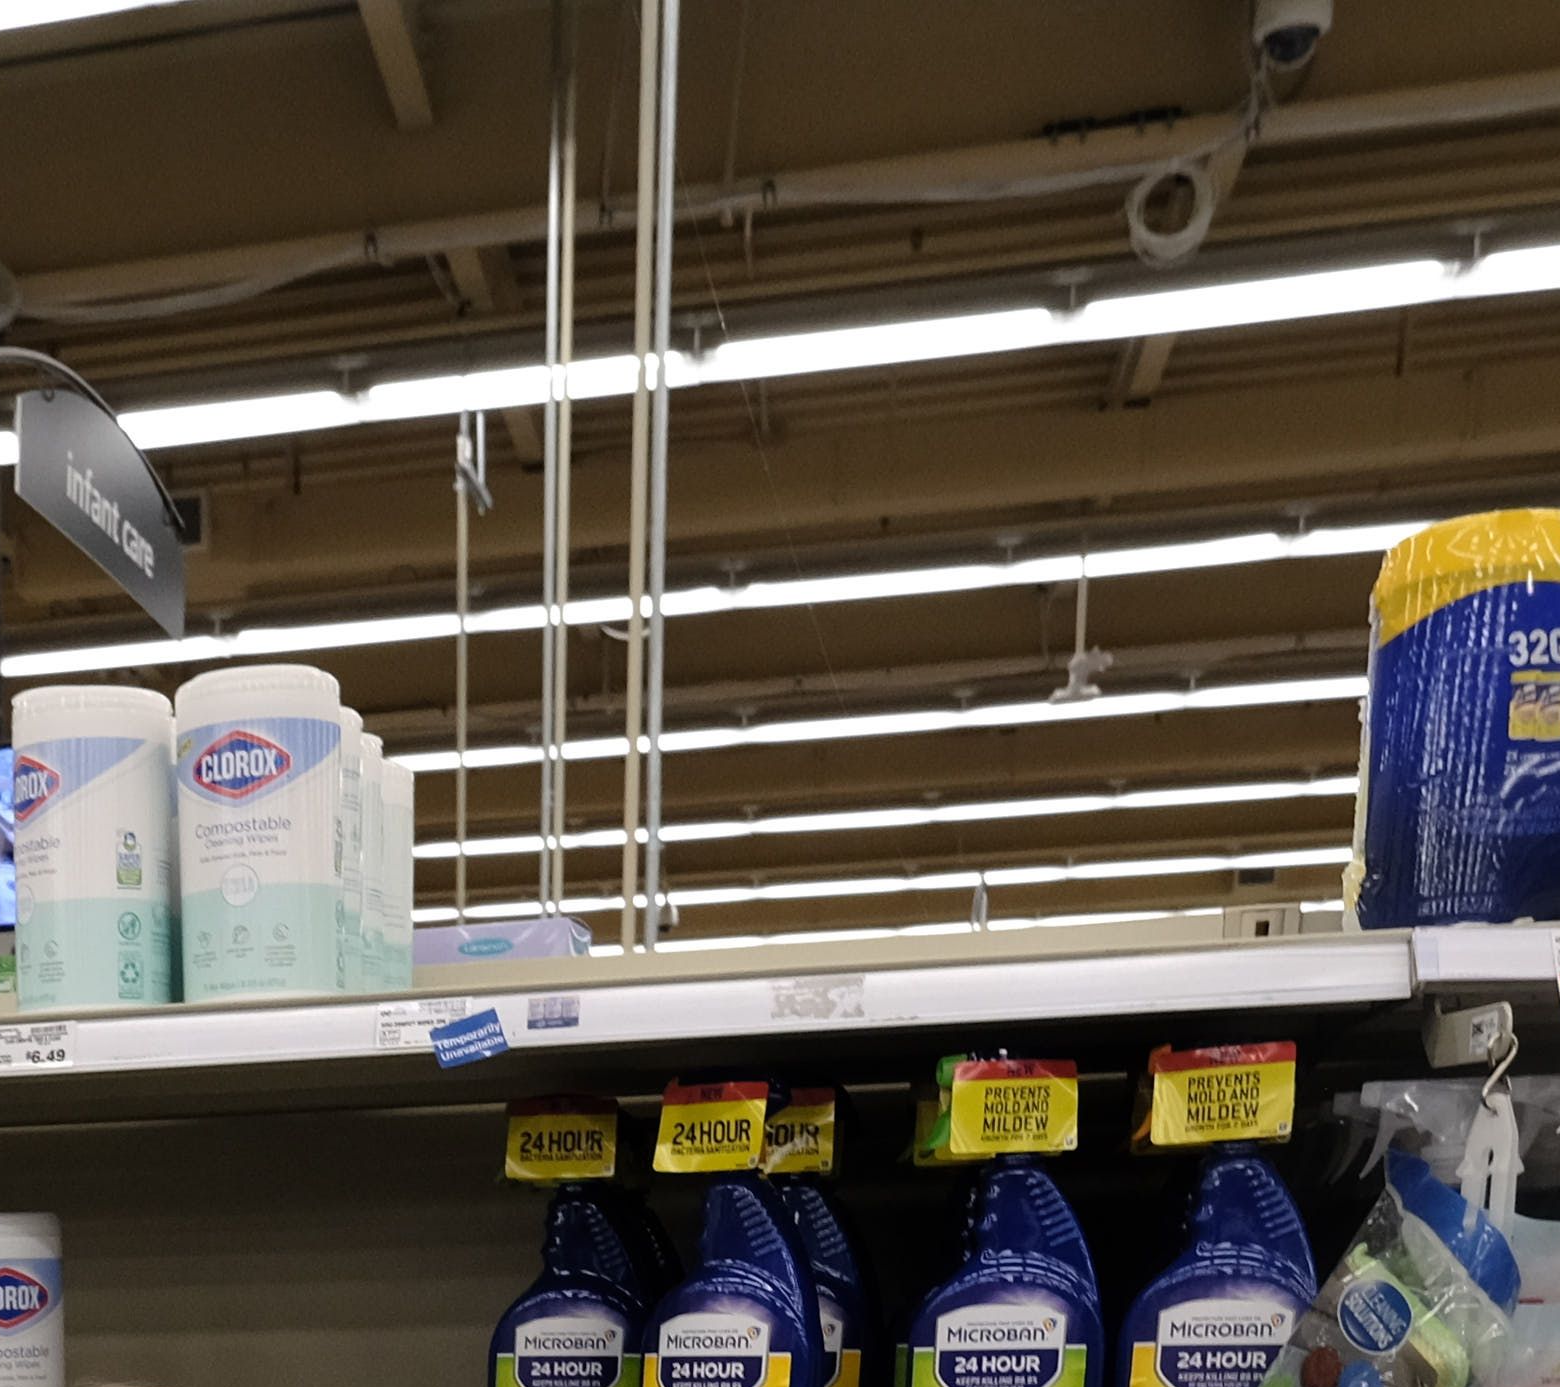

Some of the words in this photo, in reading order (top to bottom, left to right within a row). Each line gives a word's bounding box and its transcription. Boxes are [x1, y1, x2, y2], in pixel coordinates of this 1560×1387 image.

[65, 451, 121, 544] infant
[121, 517, 155, 579] care
[201, 748, 280, 783] CLOROX
[434, 1021, 502, 1053] Temporarily
[26, 1049, 65, 1064] $6.49
[1187, 1072, 1261, 1089] PREVENTS
[984, 1085, 1051, 1100] PREVENTS
[1187, 1088, 1225, 1104] MOLD
[1230, 1087, 1260, 1103] AND
[983, 1100, 1019, 1114] MOLD
[1023, 1100, 1049, 1113] AND
[1187, 1102, 1259, 1123] MILDEW
[672, 1122, 699, 1144] 24
[701, 1119, 751, 1143] HOUR
[983, 1115, 1048, 1134] MILDEW
[954, 1356, 981, 1374] 24
[983, 1355, 1040, 1373] HOUR
